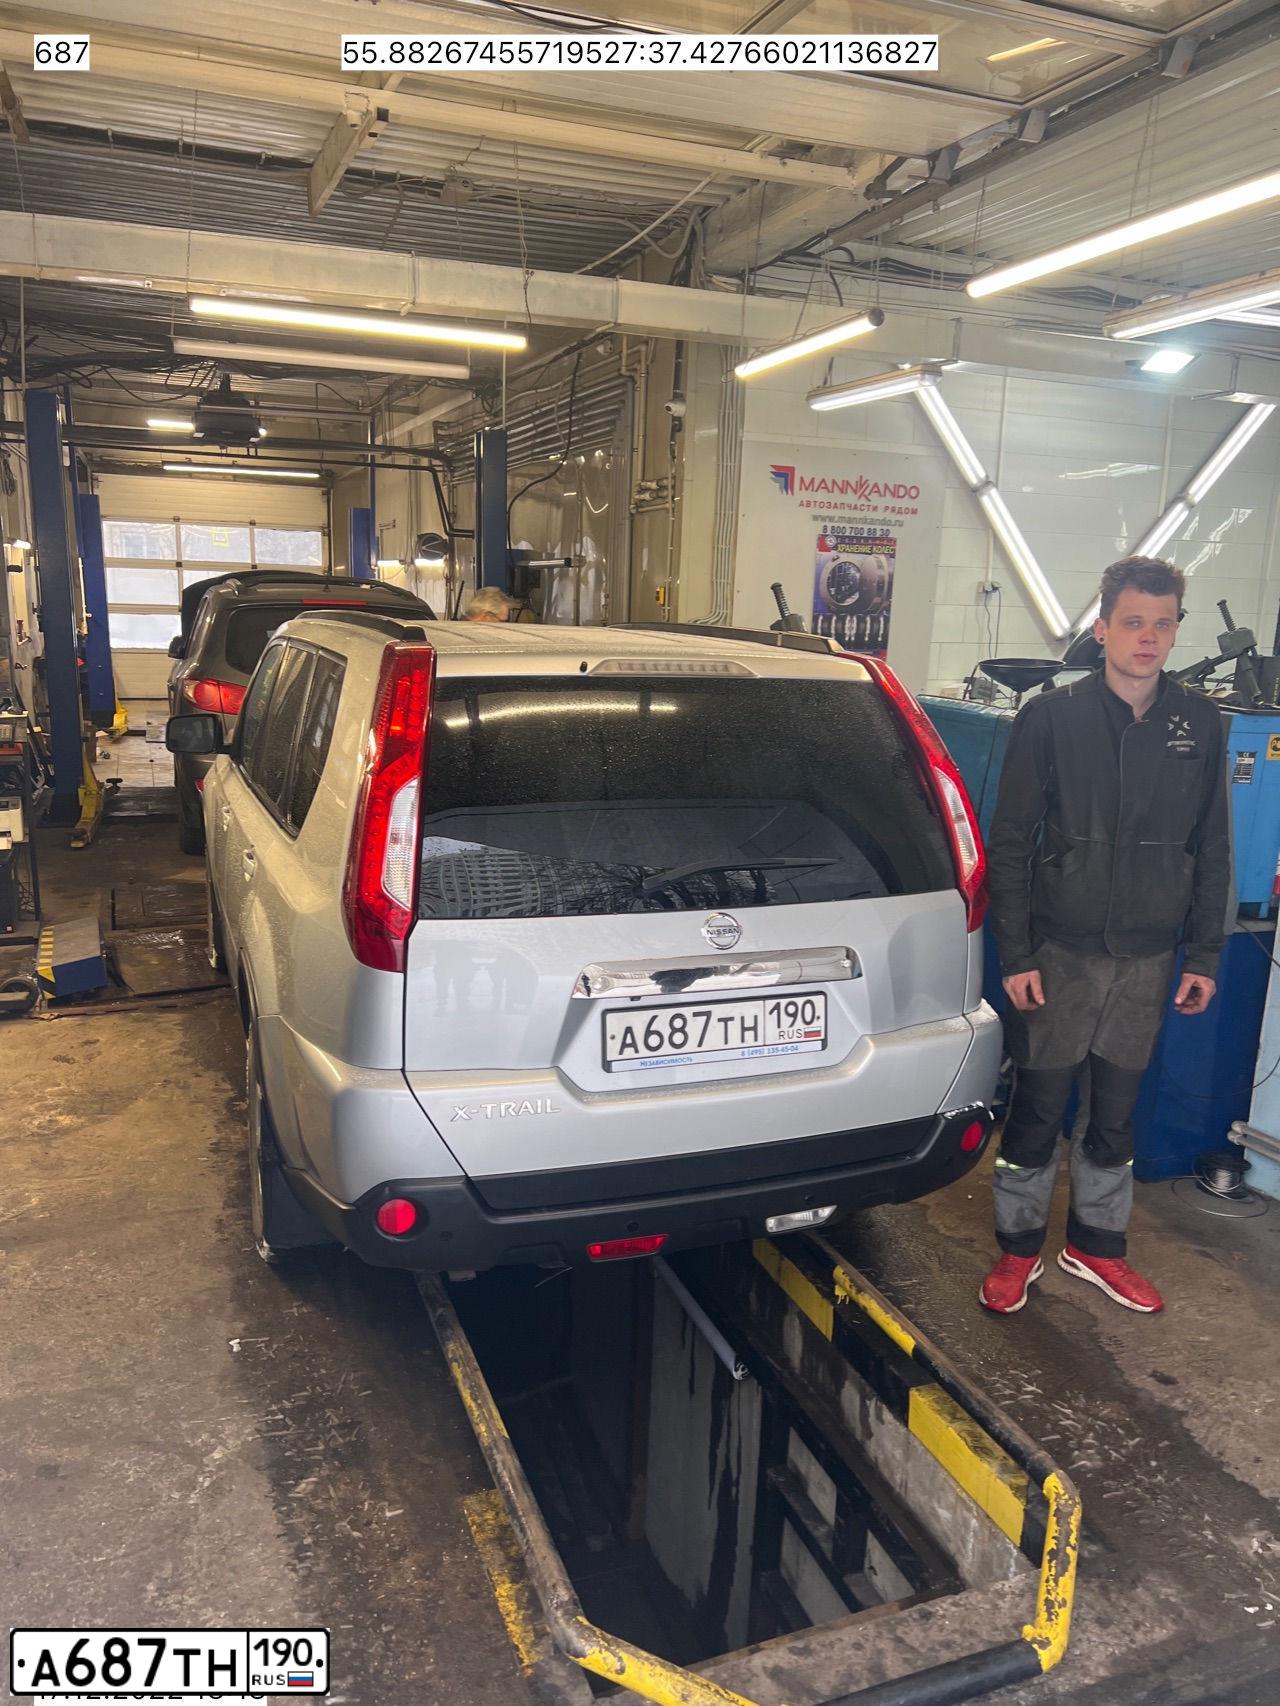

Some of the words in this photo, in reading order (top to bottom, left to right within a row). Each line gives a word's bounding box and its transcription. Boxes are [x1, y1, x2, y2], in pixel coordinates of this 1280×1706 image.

[798, 475, 920, 502] MANNKANDO
[798, 500, 879, 513] АВТОЗАПЧАСТИ
[883, 506, 919, 515] РЯДОМ
[811, 514, 905, 527] www.mannkando.ru
[822, 525, 828, 533] 8
[830, 525, 847, 534] 800
[849, 527, 865, 535] 700
[866, 528, 877, 536] 88
[836, 544, 872, 554] ХРАНЕНИЕ
[768, 999, 816, 1029] 190
[778, 1028, 803, 1039] RUS
[450, 1098, 561, 1121] X-TRAIL
